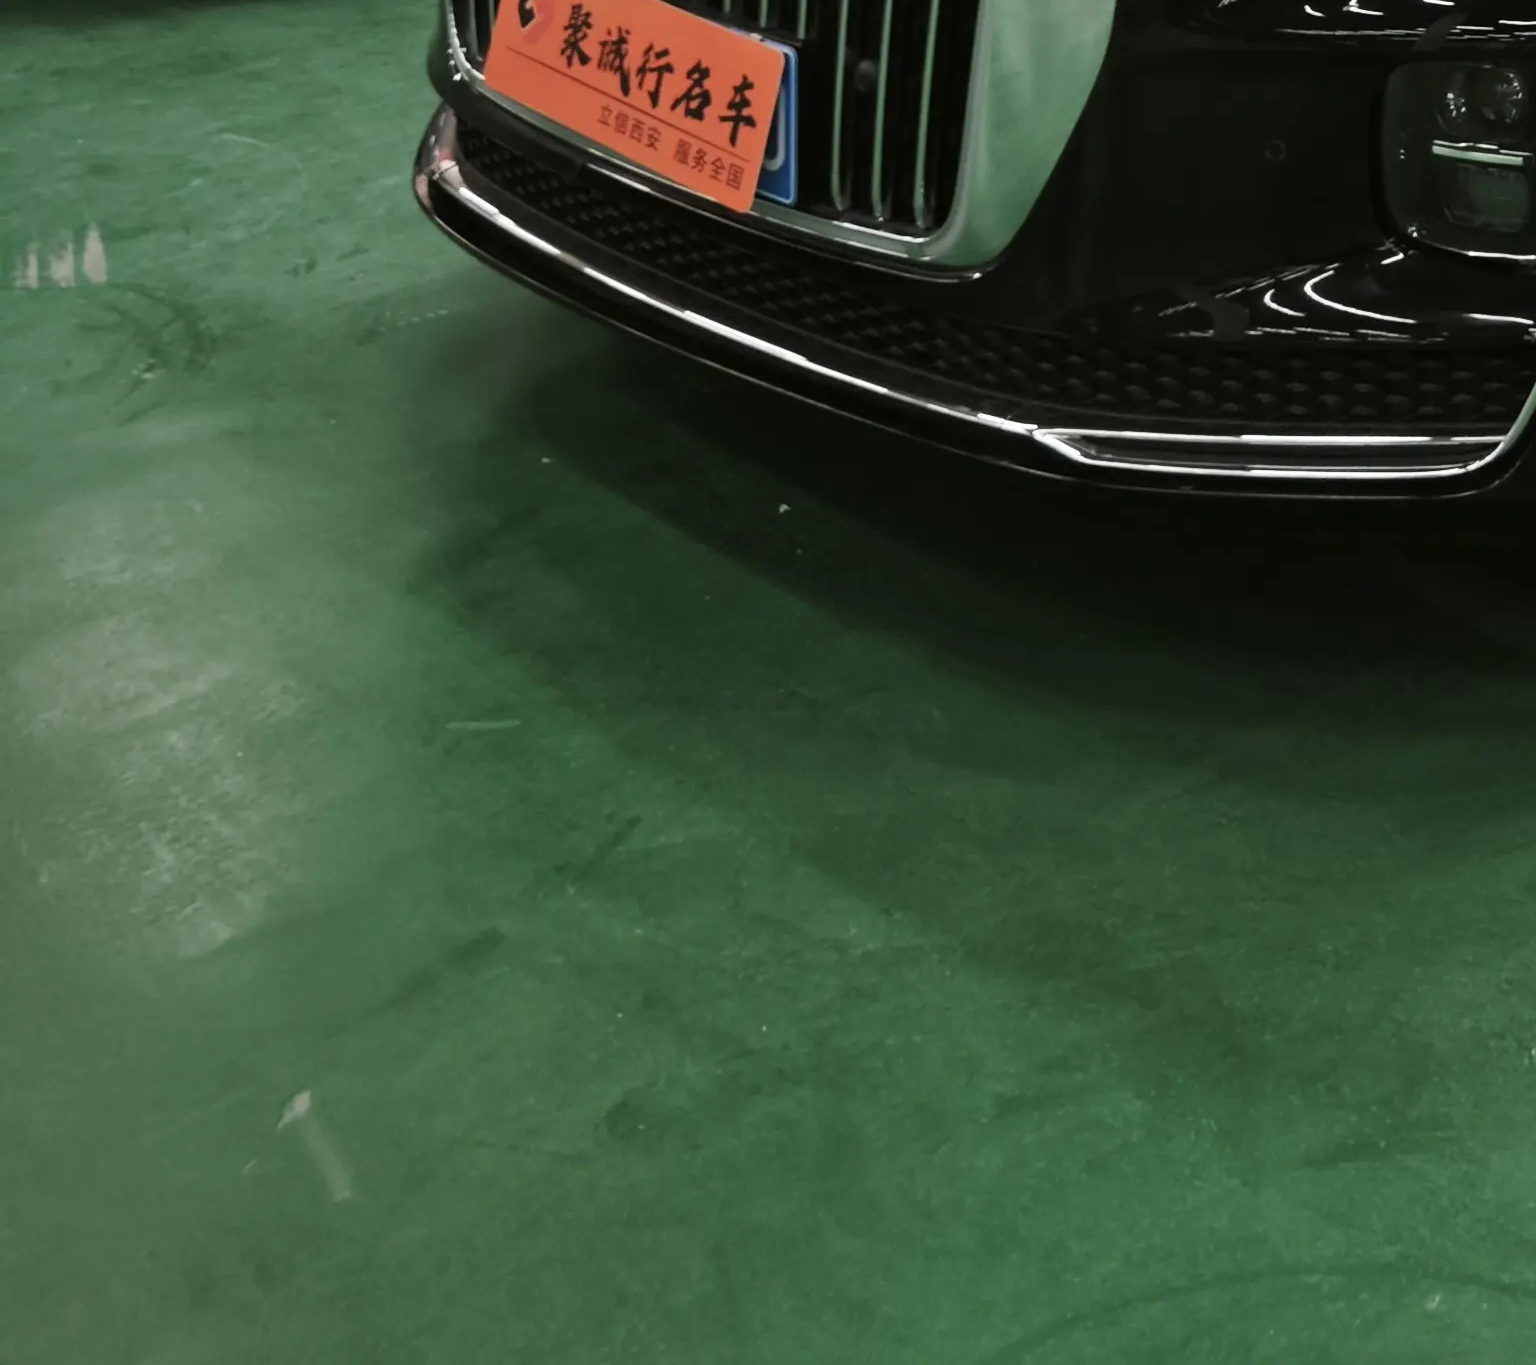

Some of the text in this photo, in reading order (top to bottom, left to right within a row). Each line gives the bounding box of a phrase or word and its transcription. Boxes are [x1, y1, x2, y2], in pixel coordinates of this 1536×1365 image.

[559, 3, 757, 148] 聚诚行名车
[673, 137, 745, 191] 服务全国
